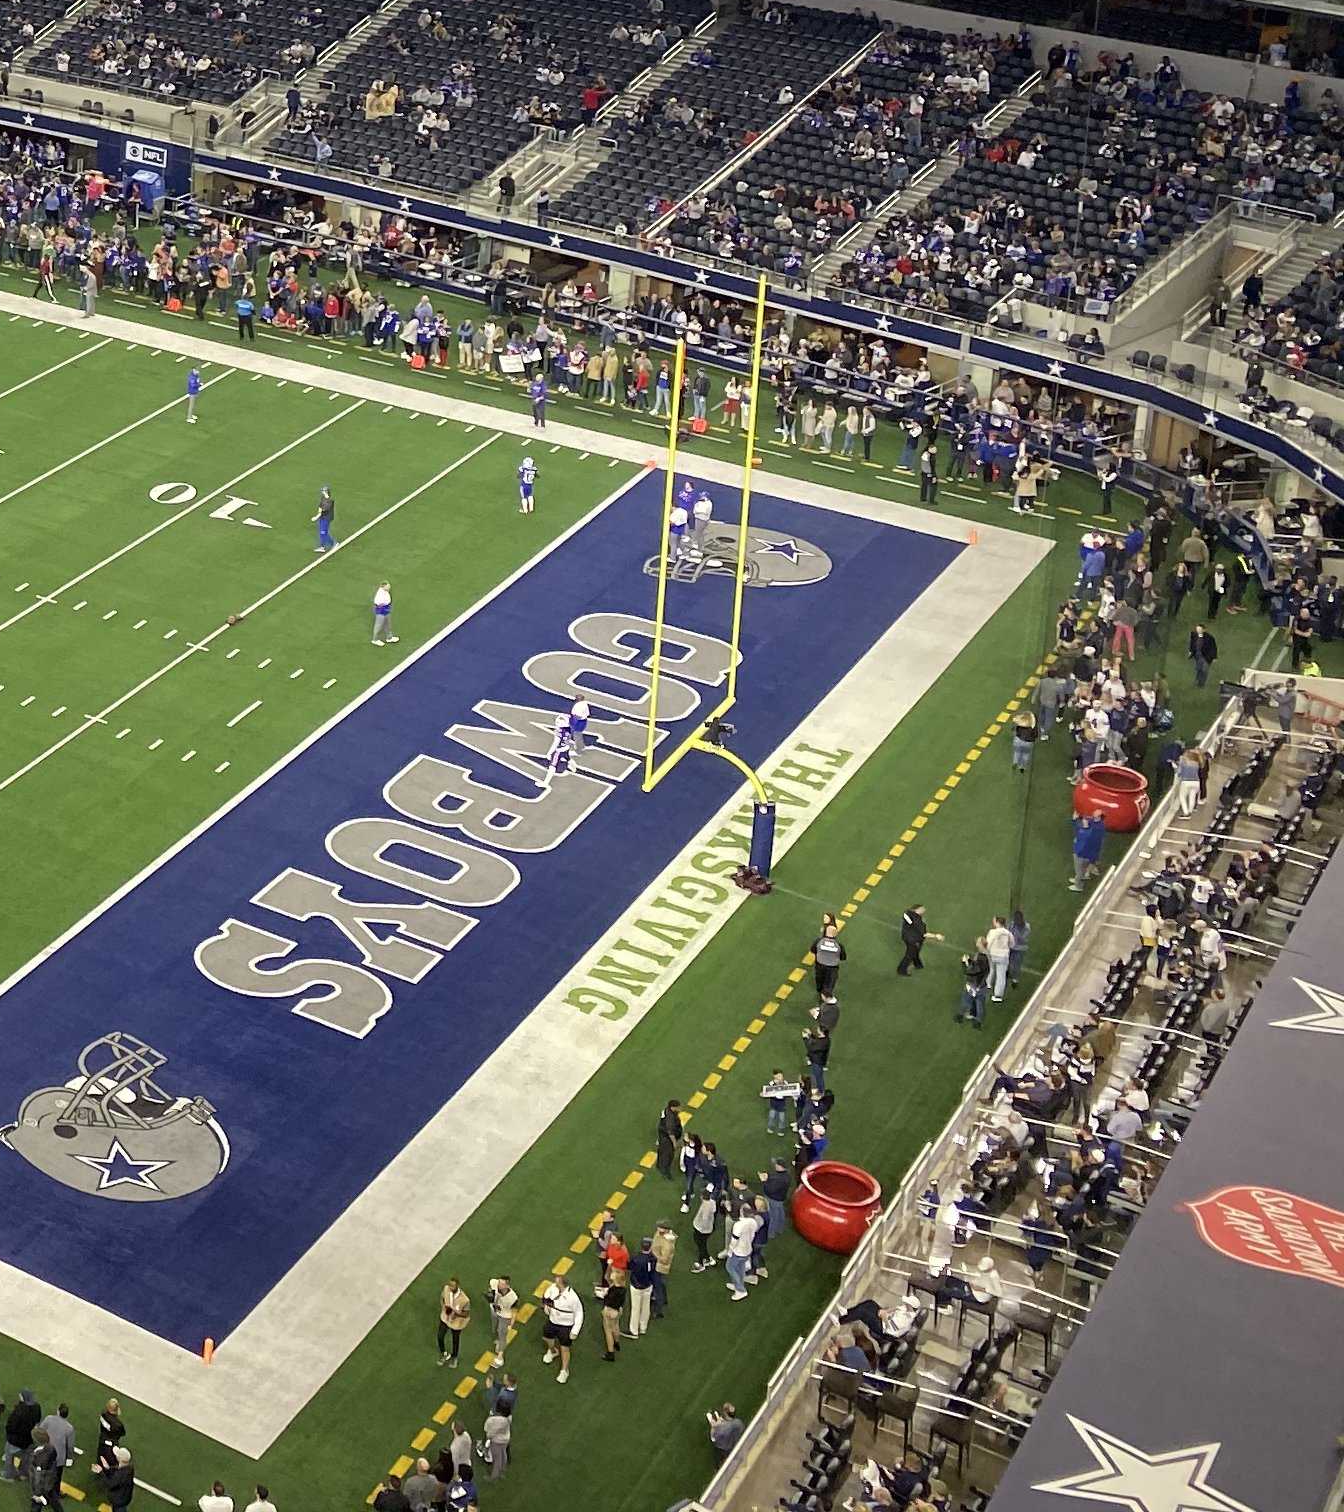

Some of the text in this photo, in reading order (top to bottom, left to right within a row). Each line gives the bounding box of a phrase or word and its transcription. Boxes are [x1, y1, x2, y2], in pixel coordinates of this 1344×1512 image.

[143, 149, 164, 163] NFL
[148, 479, 257, 526] 10
[193, 611, 745, 1039] COWBOYS
[562, 742, 855, 1022] THANKSGIVING
[1216, 1201, 1291, 1264] ARMY
